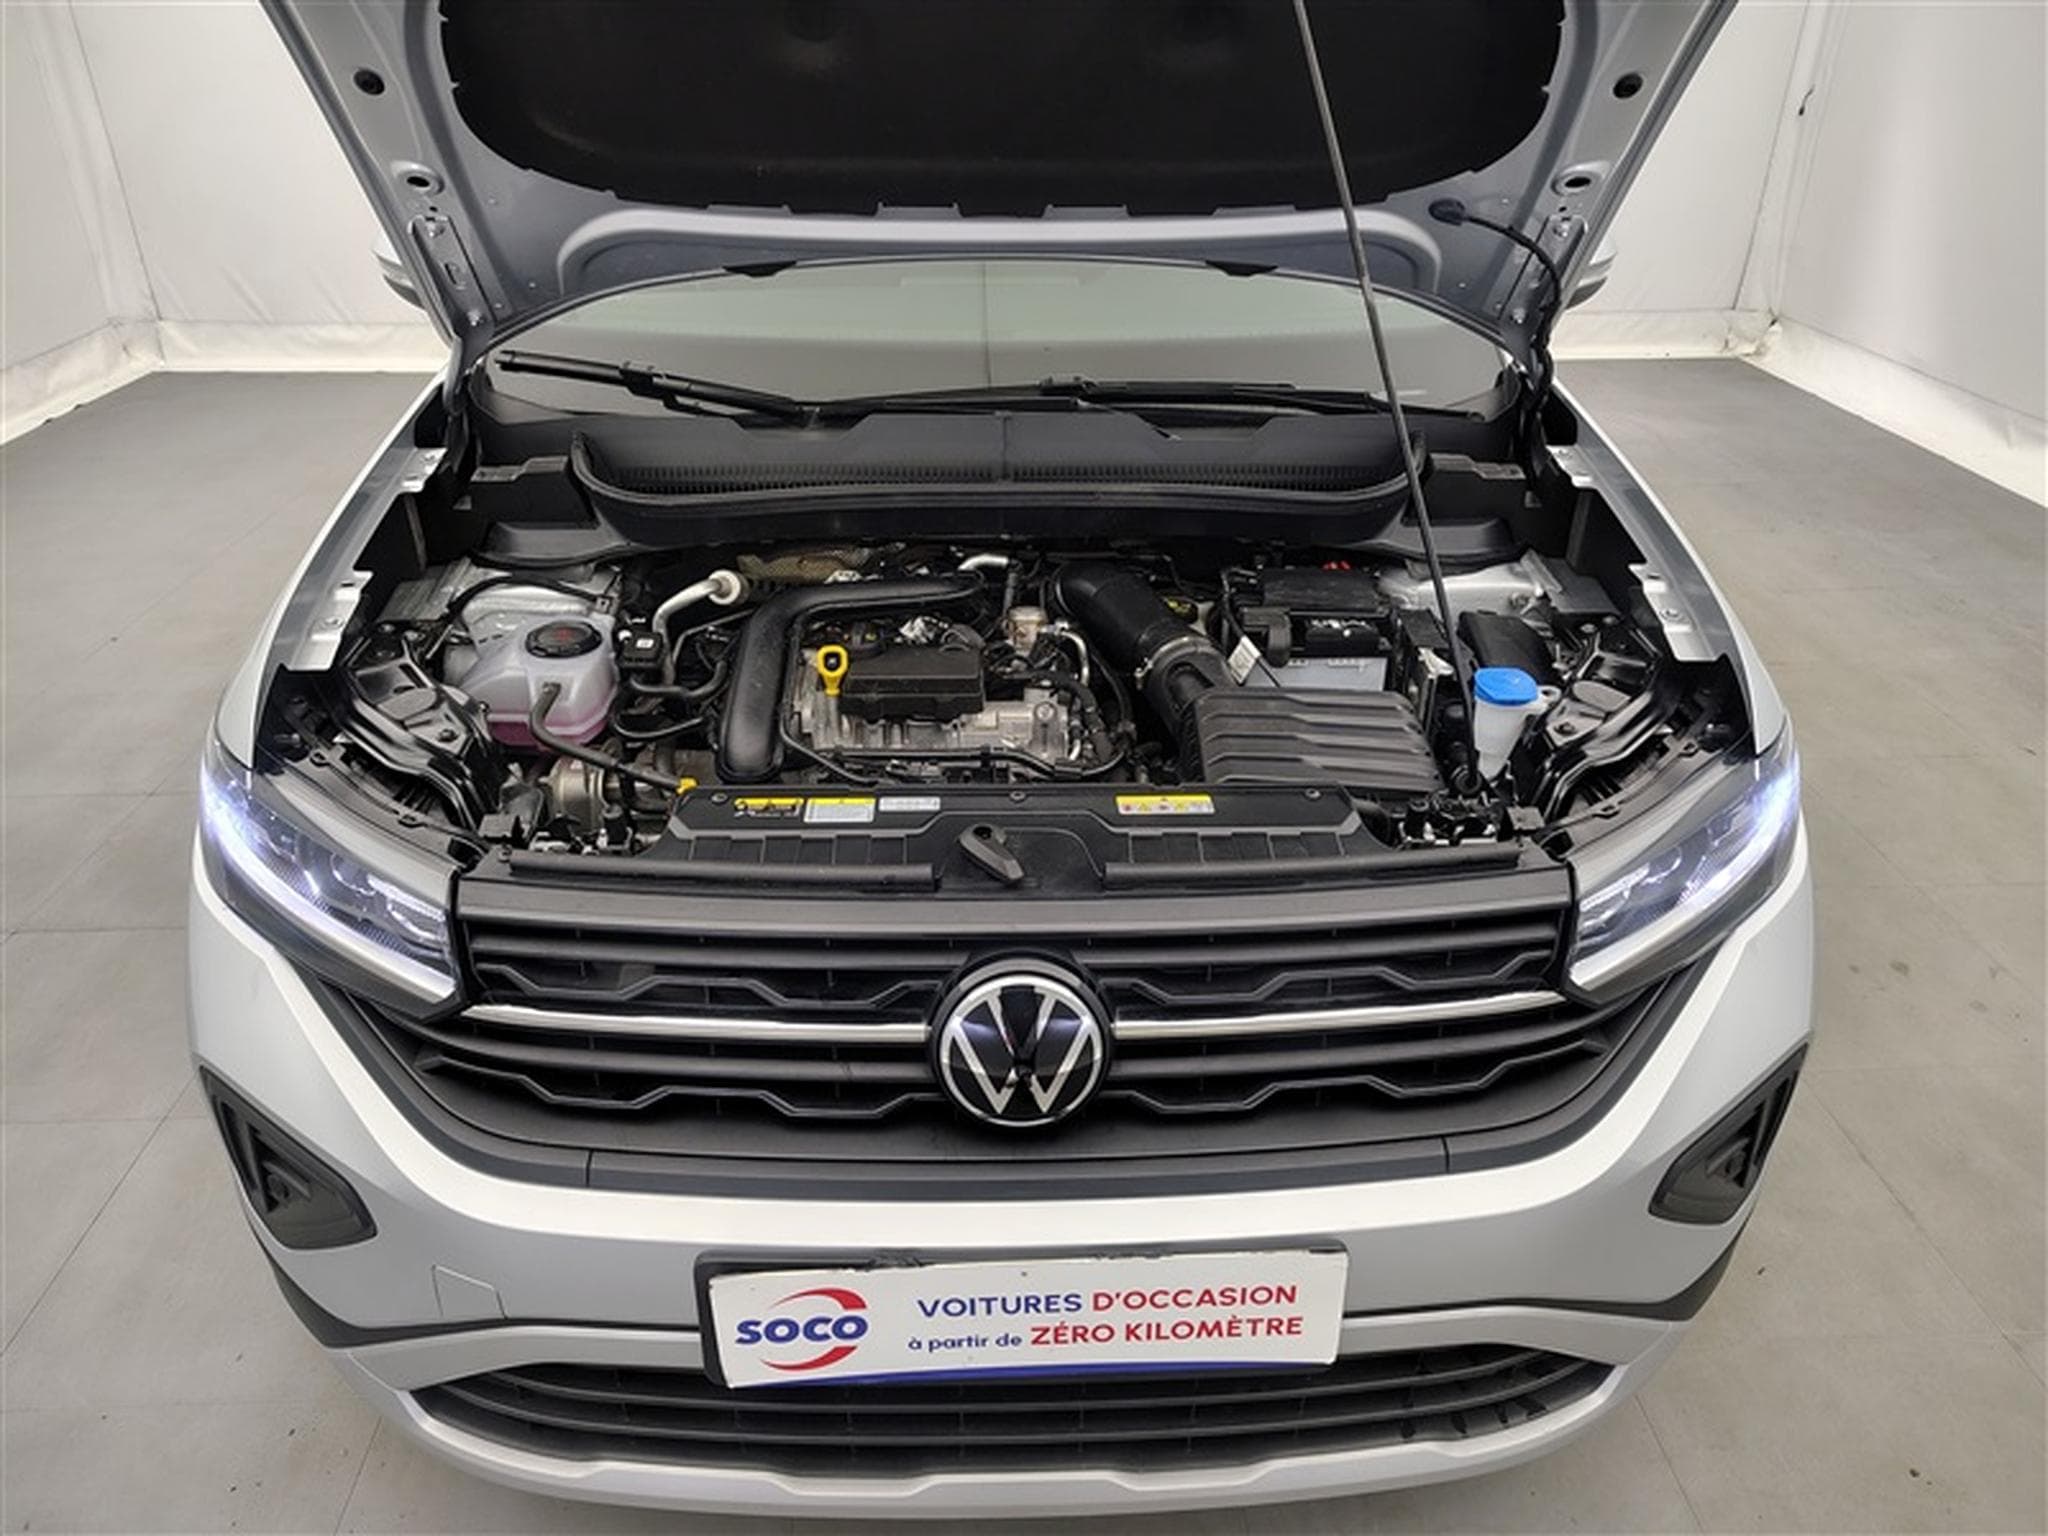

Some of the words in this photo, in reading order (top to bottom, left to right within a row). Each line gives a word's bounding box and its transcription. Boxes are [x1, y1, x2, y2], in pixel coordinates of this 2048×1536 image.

[917, 1293, 1083, 1319] VOITURES
[1092, 1284, 1298, 1314] D'OCCASION
[735, 1314, 869, 1345] SOCO
[908, 1335, 923, 1352] à
[927, 1331, 989, 1353] partir
[995, 1330, 1022, 1349] de
[1030, 1319, 1116, 1347] ZÉRO
[1124, 1315, 1304, 1343] KILOMÈTRE
